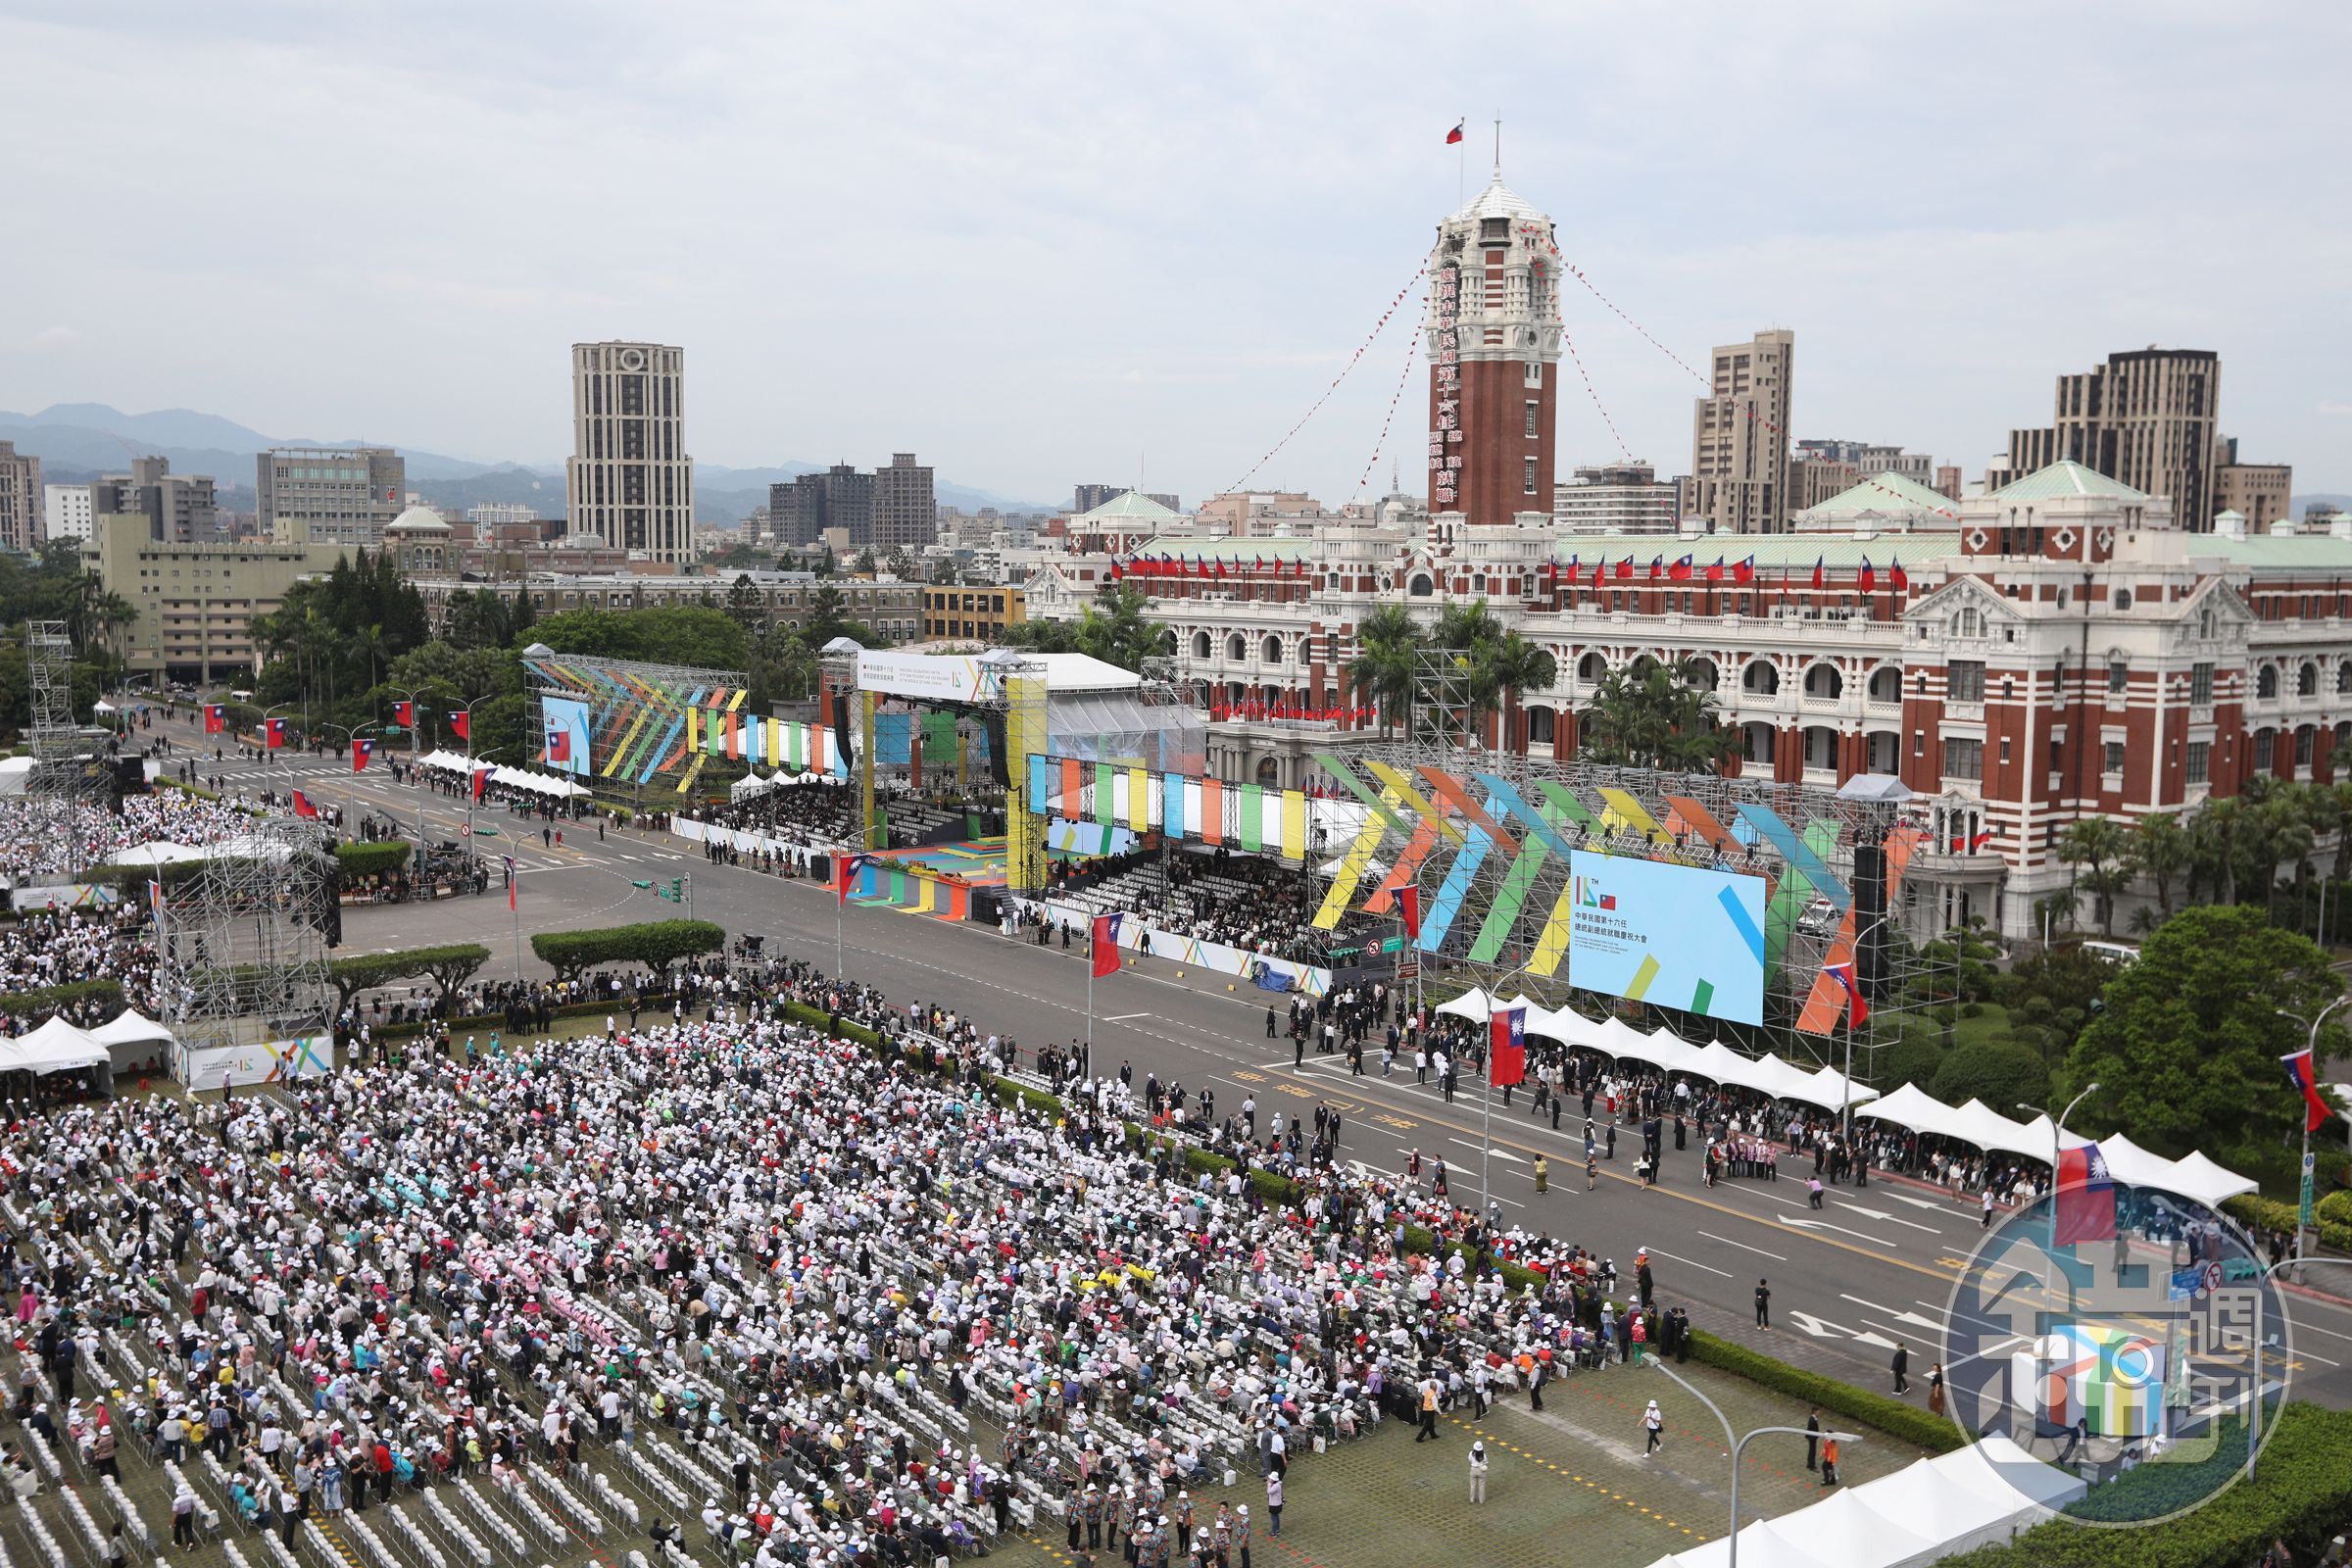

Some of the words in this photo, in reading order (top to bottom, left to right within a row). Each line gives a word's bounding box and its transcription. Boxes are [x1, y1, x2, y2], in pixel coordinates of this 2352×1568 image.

[1437, 267, 1456, 430] 慶祝中華民國第十六任
[1436, 469, 1454, 503] 就職
[1574, 911, 1628, 928] 中華民國第十六任
[1574, 922, 1647, 944] 總統副總統就職慶祝大會
